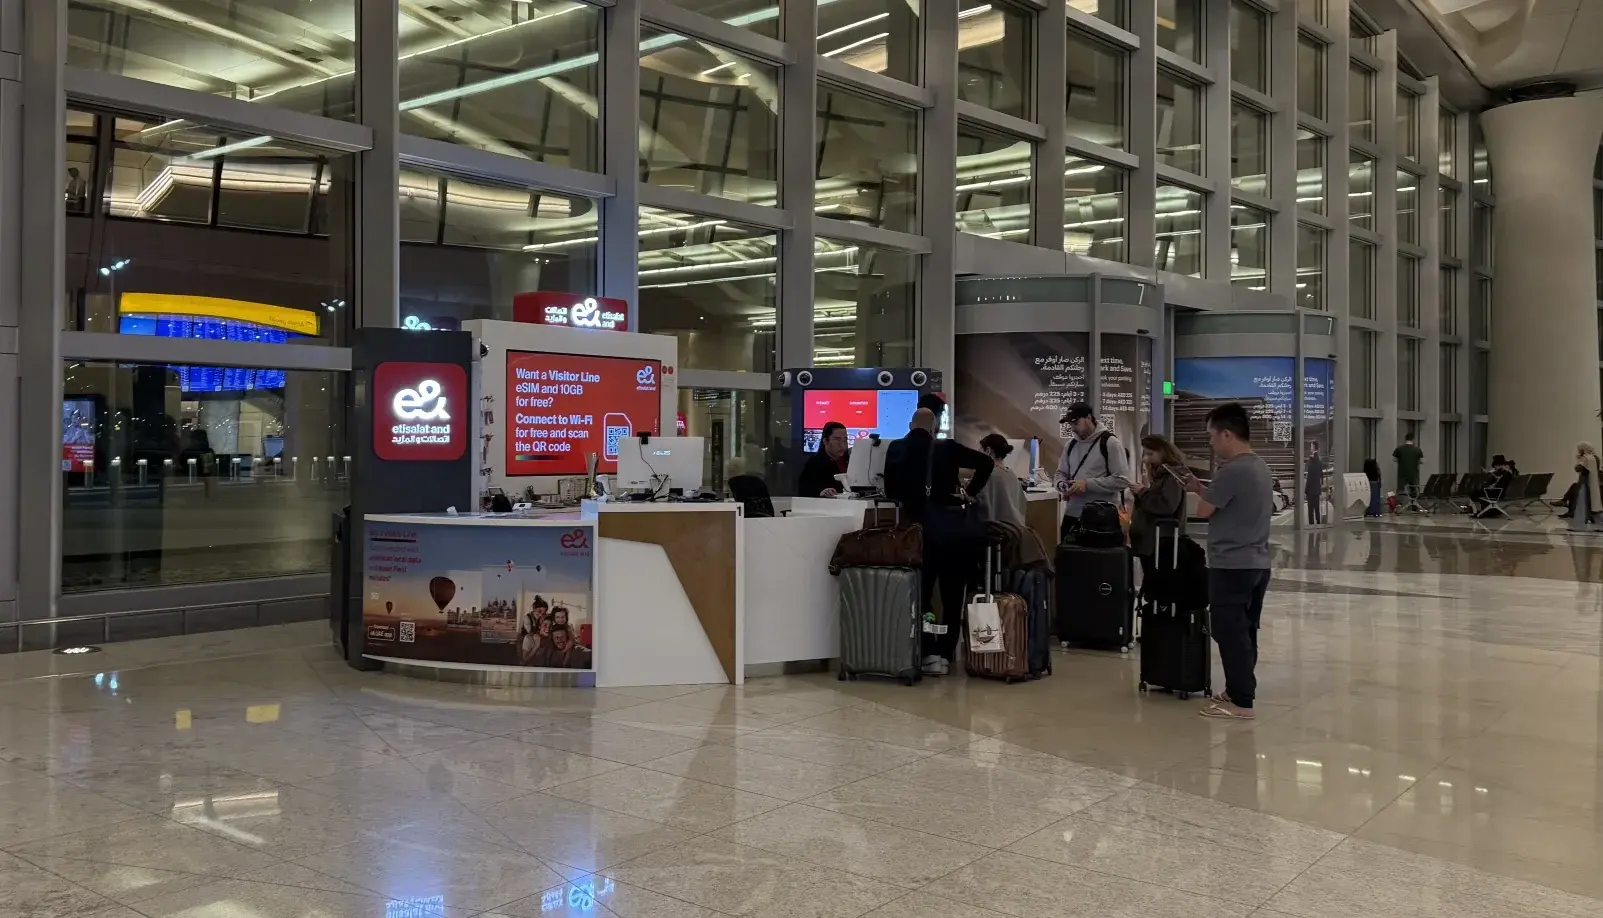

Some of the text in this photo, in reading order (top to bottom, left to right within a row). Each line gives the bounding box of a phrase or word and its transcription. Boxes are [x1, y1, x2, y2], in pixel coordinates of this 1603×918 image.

[1137, 283, 1144, 304] 7
[1327, 317, 1333, 335] 7
[515, 368, 600, 383] Want a Visitor Line
[515, 382, 583, 395] eSIM and 10GB
[515, 396, 554, 407] for free?
[515, 413, 593, 425] Connect to Wi-Fi
[391, 424, 451, 434] etisalat and
[515, 427, 589, 439] for free and scan
[515, 441, 571, 452] the QR code
